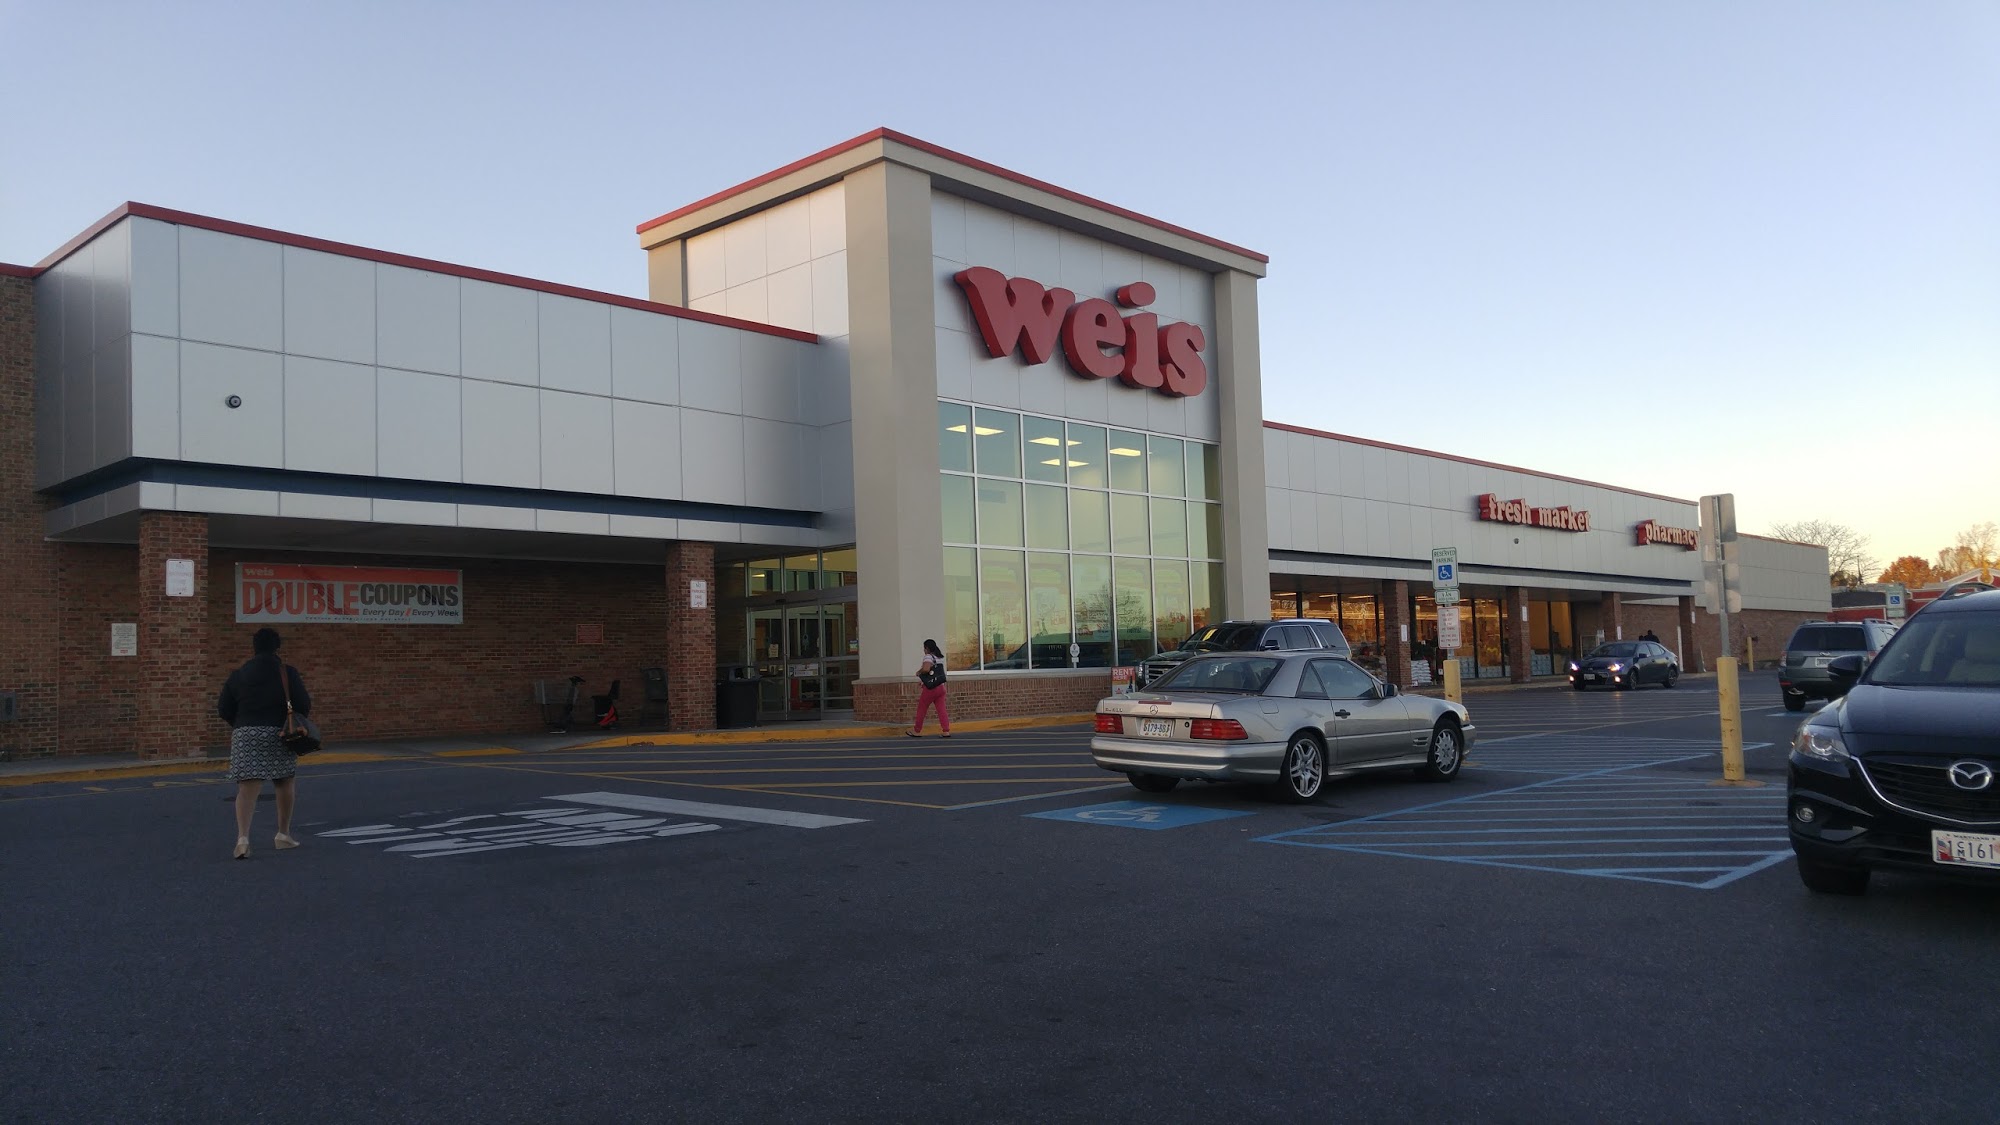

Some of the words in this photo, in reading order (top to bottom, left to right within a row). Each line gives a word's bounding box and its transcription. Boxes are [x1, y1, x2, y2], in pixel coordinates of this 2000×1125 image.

[1479, 493, 1532, 525] fresh
[1537, 505, 1591, 532] market
[1637, 519, 1700, 551] pharmacy
[243, 581, 359, 615] DOUBLE
[360, 584, 459, 607] COUPONS
[362, 608, 387, 617] Every
[1112, 668, 1134, 676] RENT
